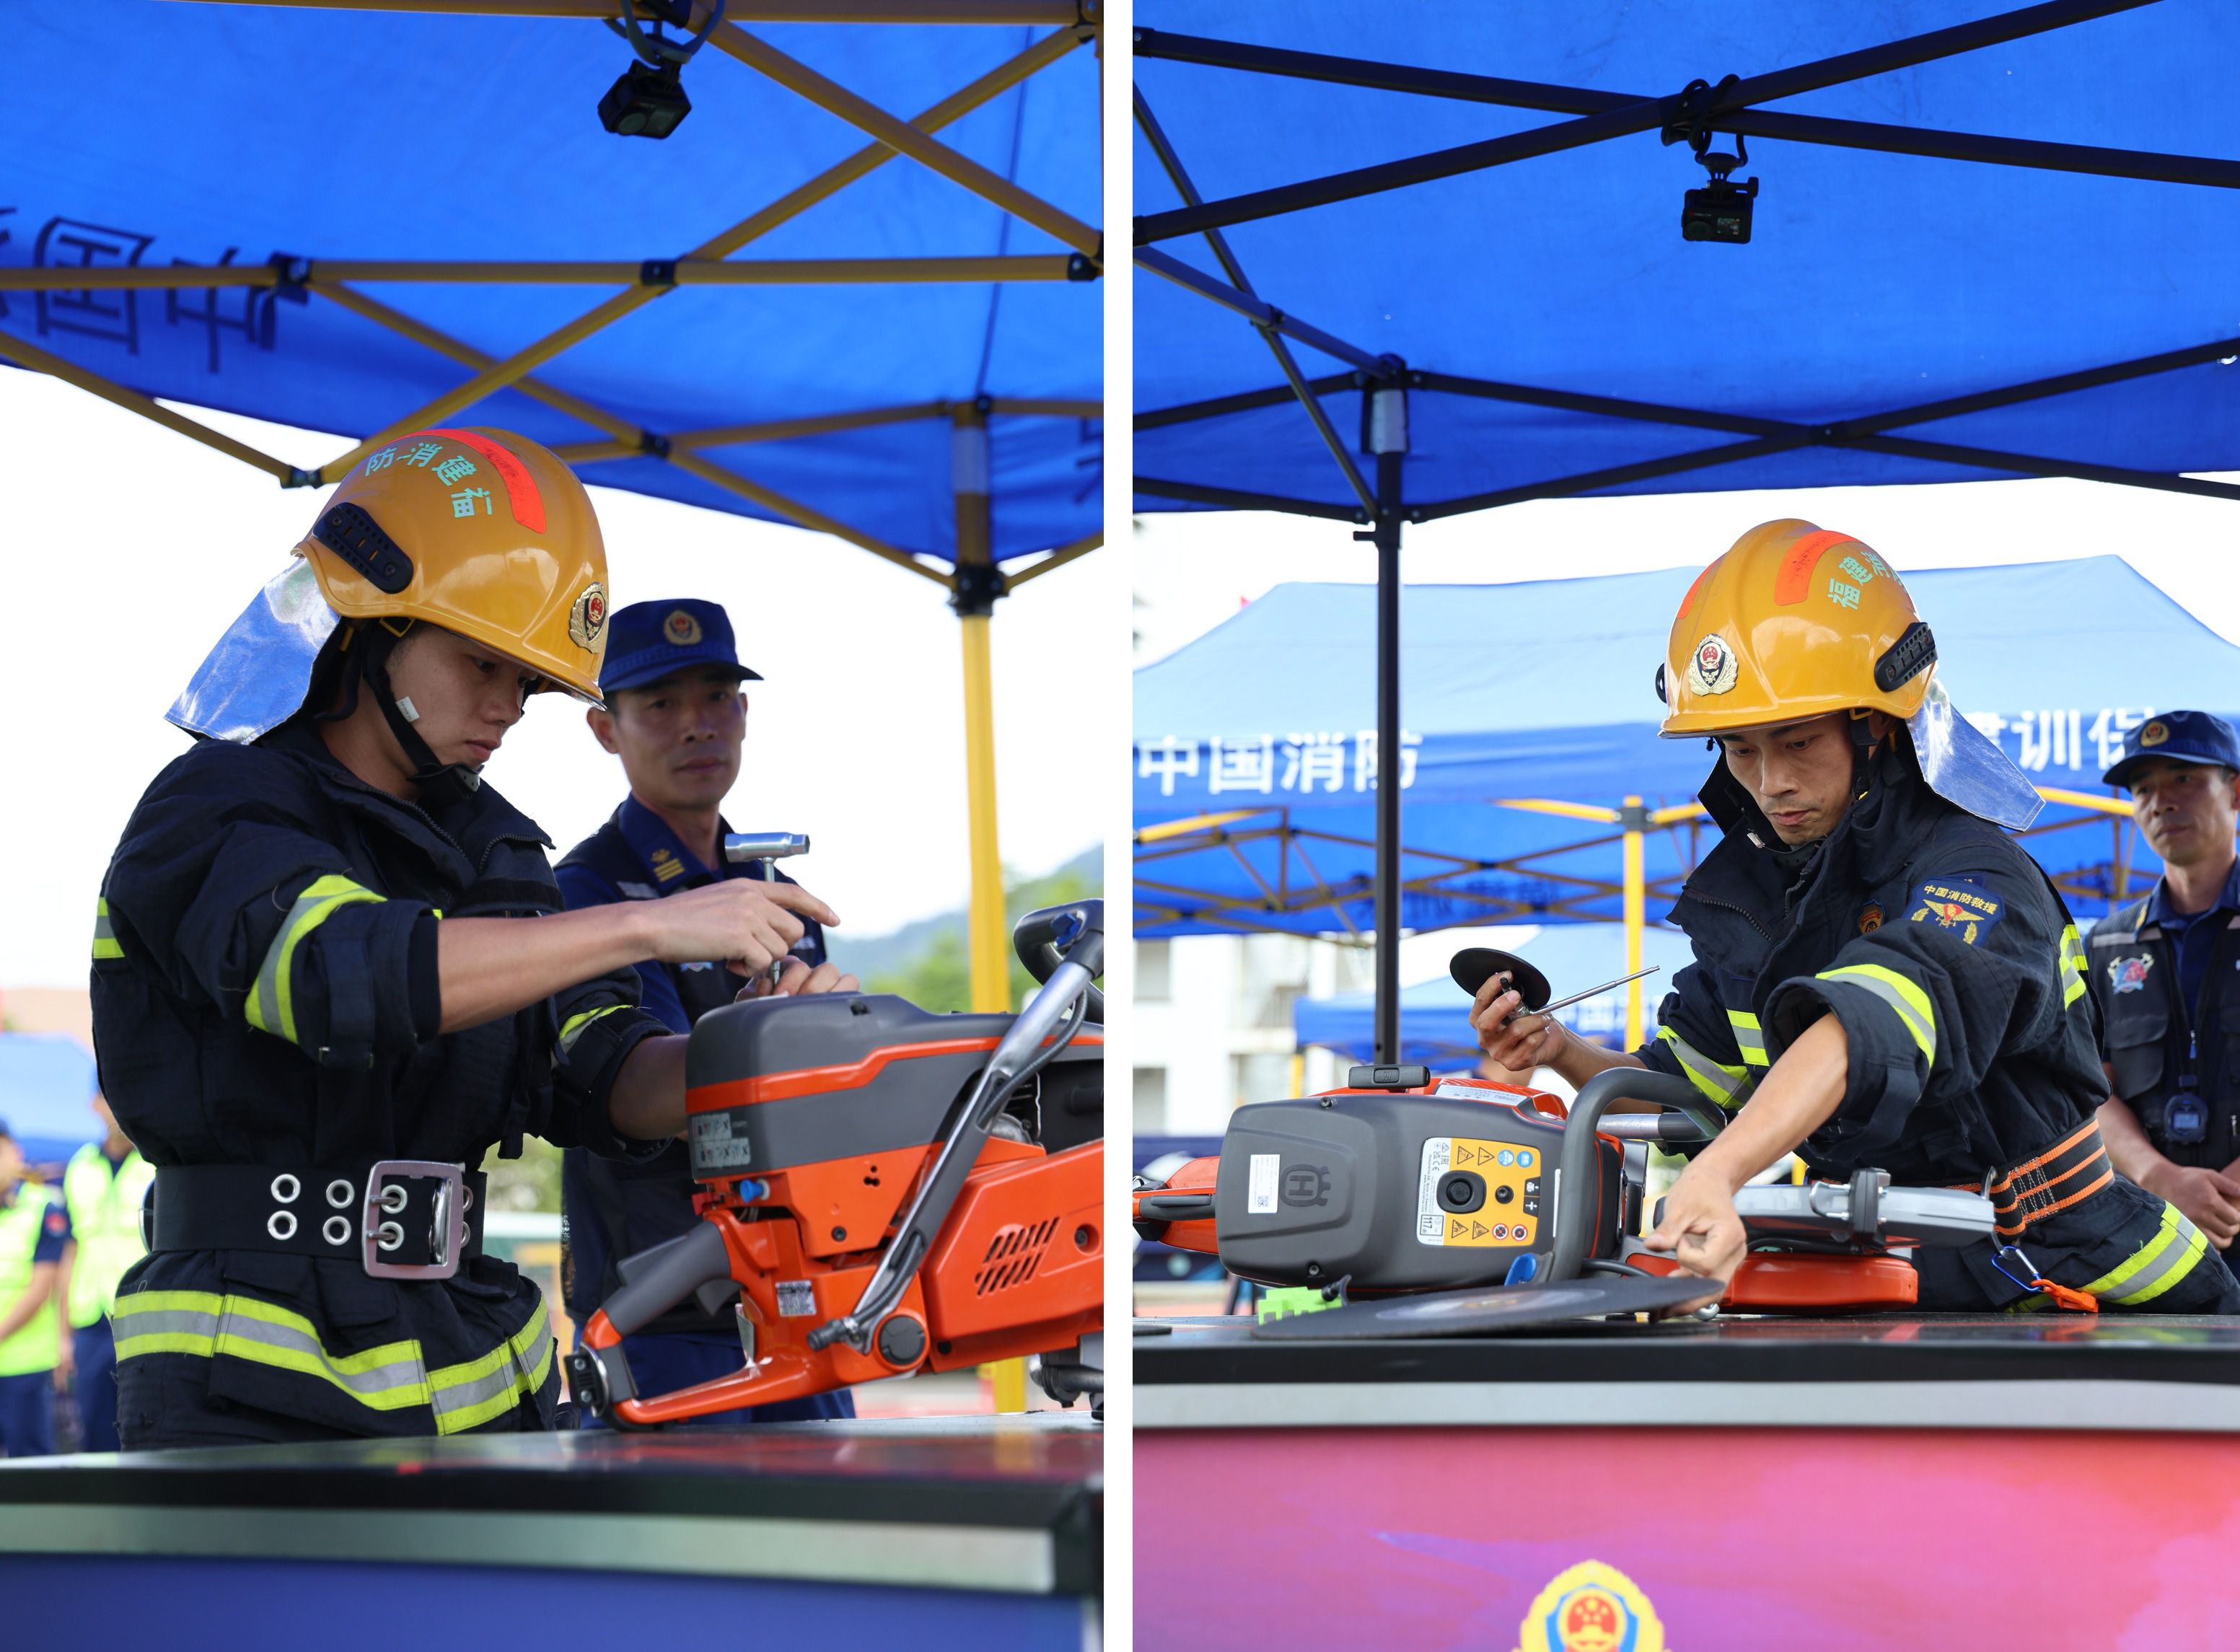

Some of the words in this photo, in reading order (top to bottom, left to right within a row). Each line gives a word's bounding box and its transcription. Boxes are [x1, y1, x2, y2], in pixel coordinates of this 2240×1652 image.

[1923, 884, 1998, 915] 中国消防救援
[1423, 1216, 1433, 1229] 117
